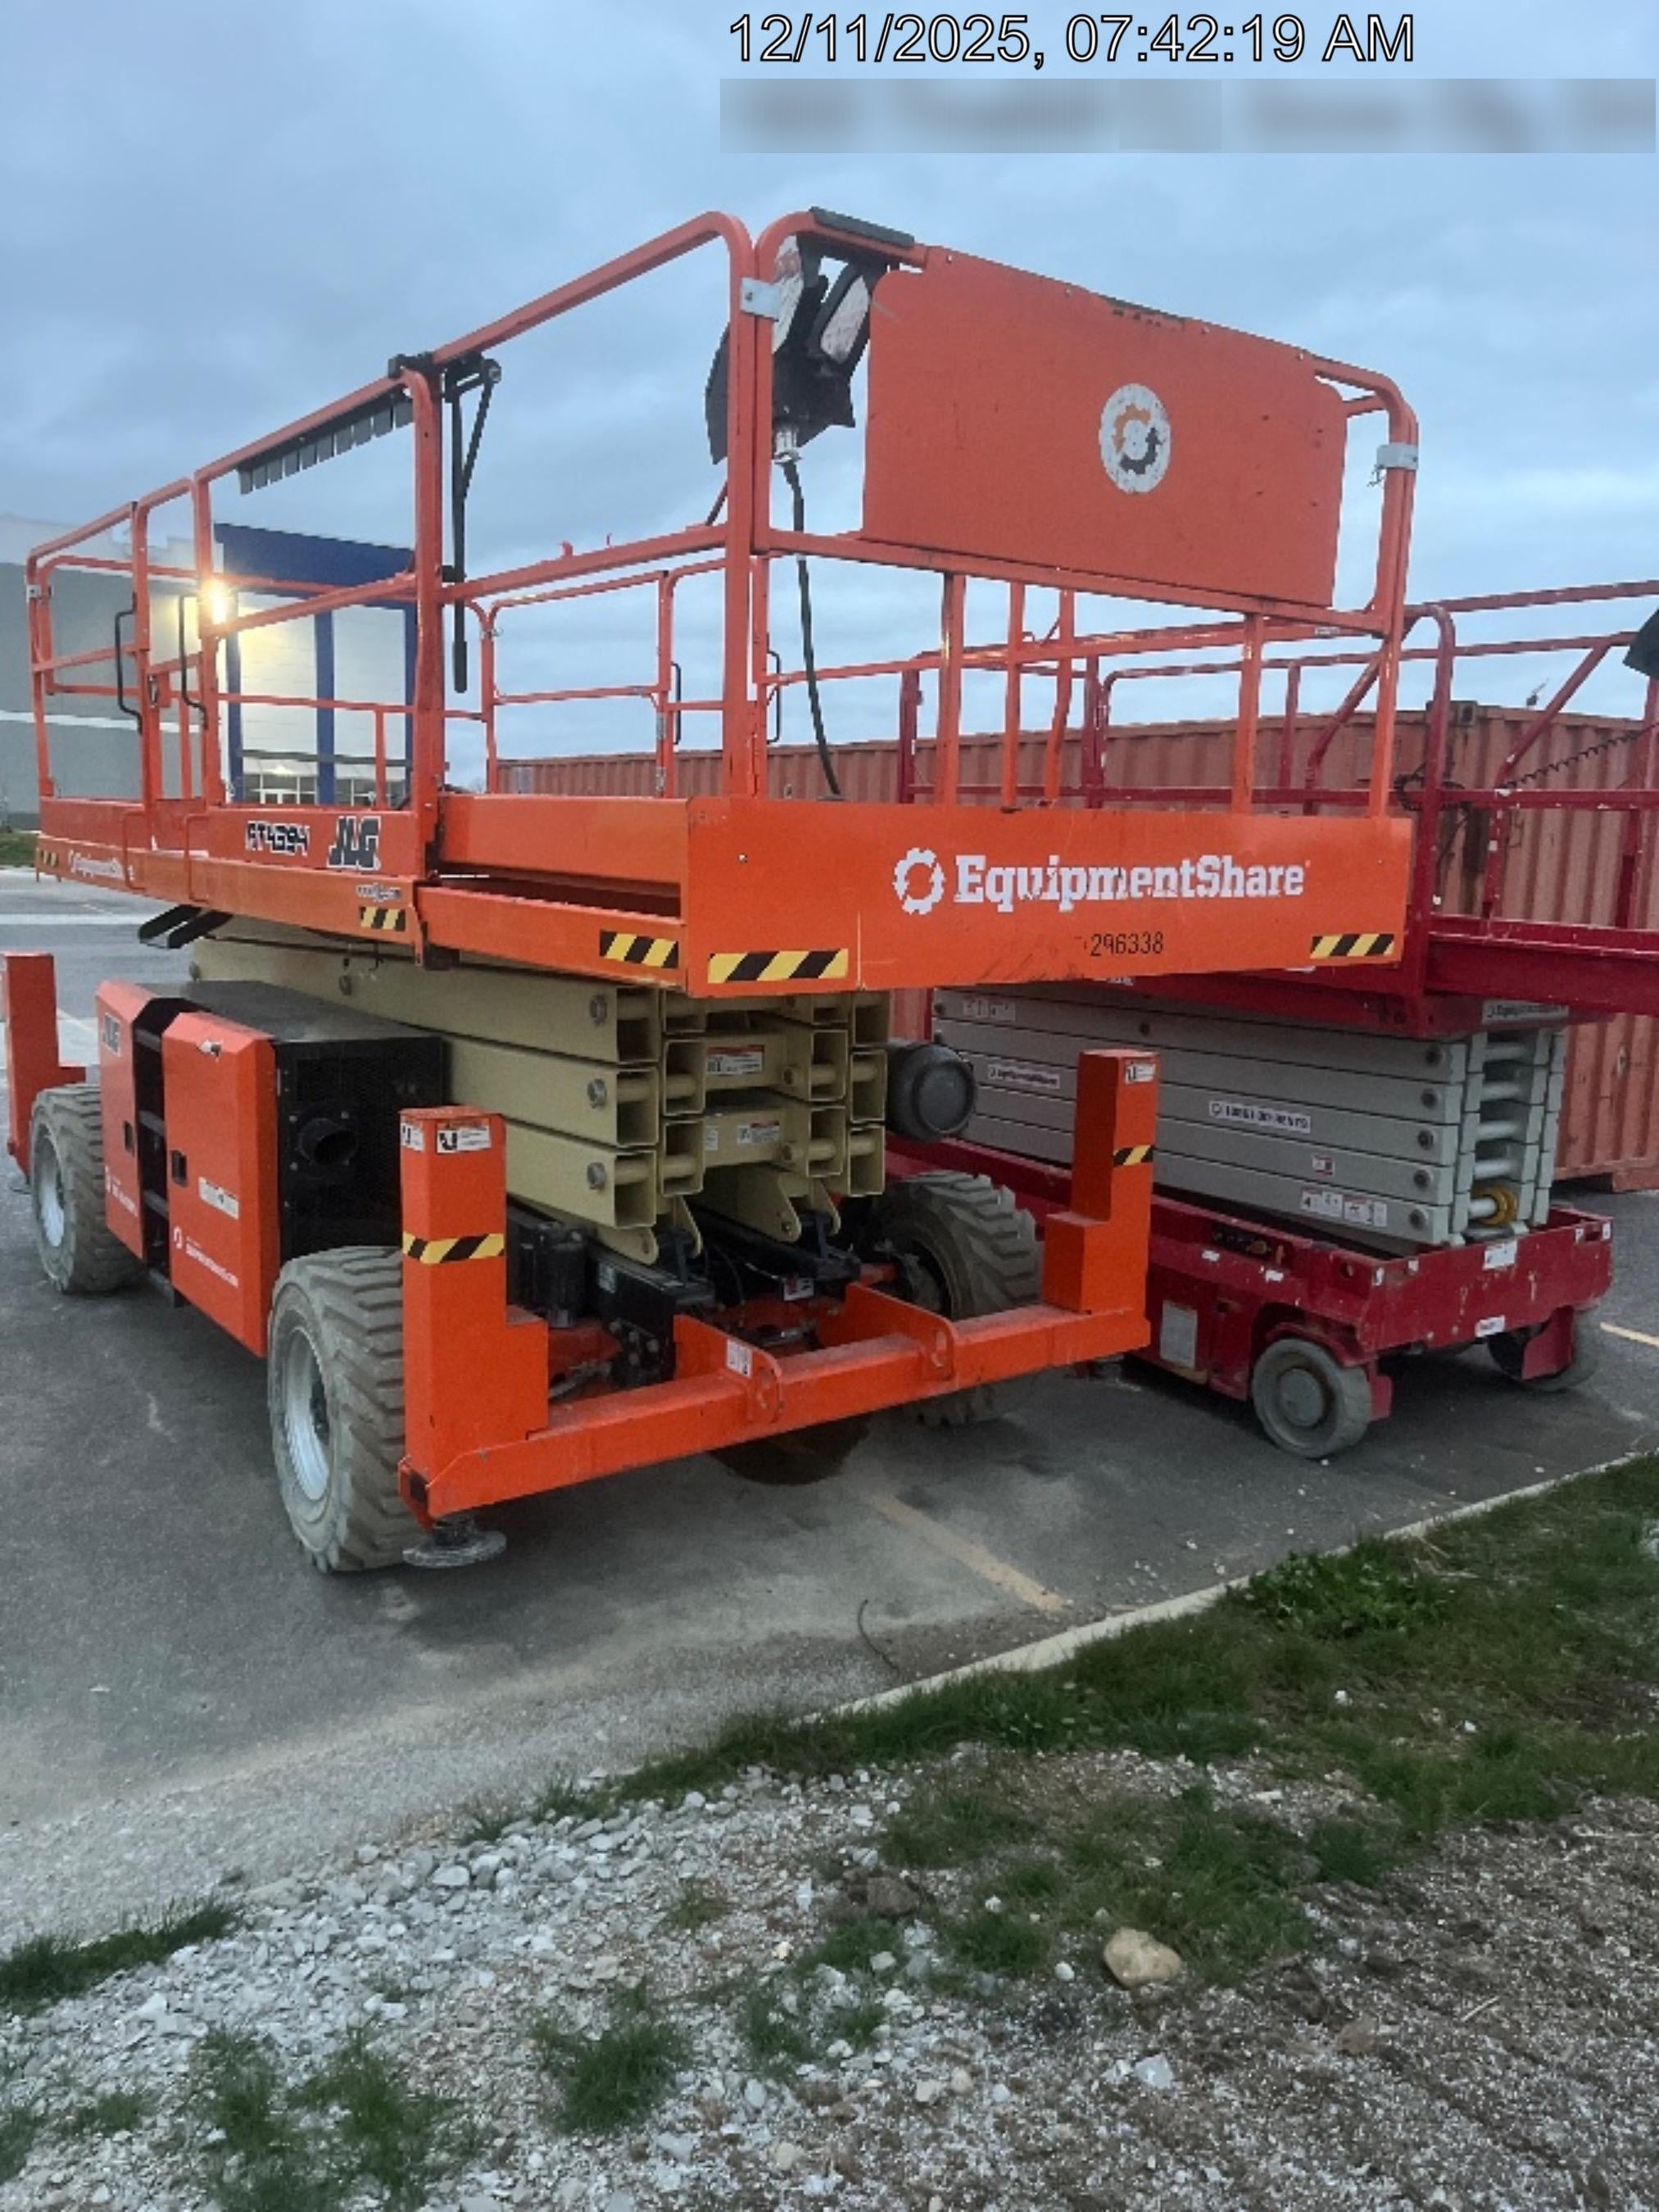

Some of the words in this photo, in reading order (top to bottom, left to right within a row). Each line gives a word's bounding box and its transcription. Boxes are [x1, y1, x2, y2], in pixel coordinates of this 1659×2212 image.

[327, 816, 381, 870] JLG
[954, 854, 1305, 913] EquipmentShare
[1090, 931, 1164, 957] 296338
